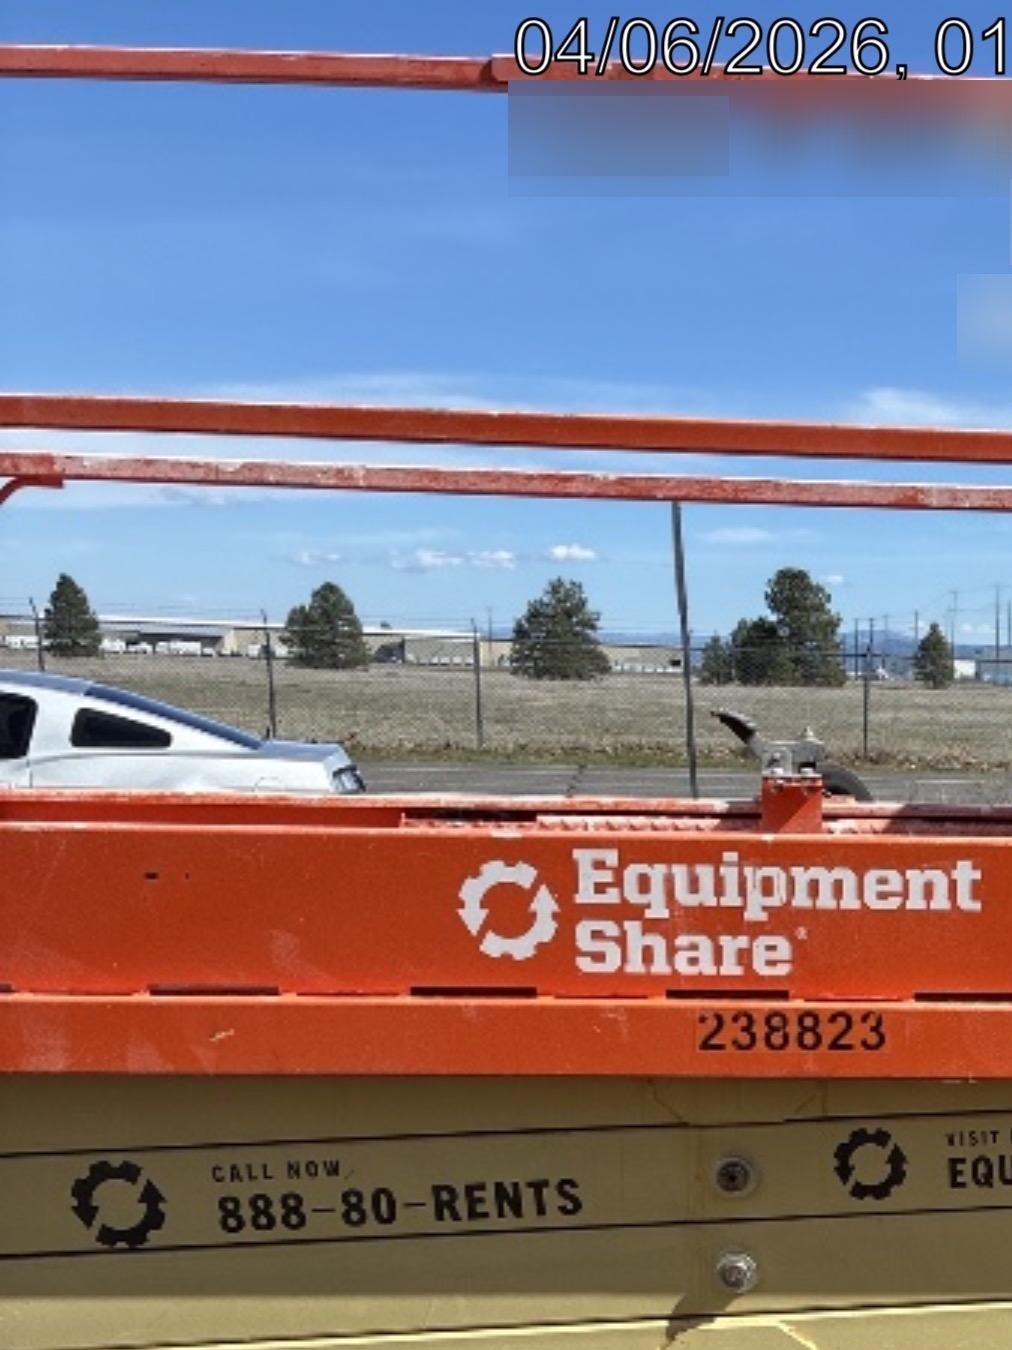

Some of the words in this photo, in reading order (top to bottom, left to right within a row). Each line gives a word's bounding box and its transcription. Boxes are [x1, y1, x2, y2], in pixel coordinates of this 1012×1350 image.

[572, 848, 982, 921] Equipment
[574, 920, 793, 976] Share
[698, 1010, 886, 1051] 238823
[212, 1163, 274, 1183] CALL
[287, 1160, 341, 1180] NOW
[218, 1177, 584, 1234] 888-80-RENTS
